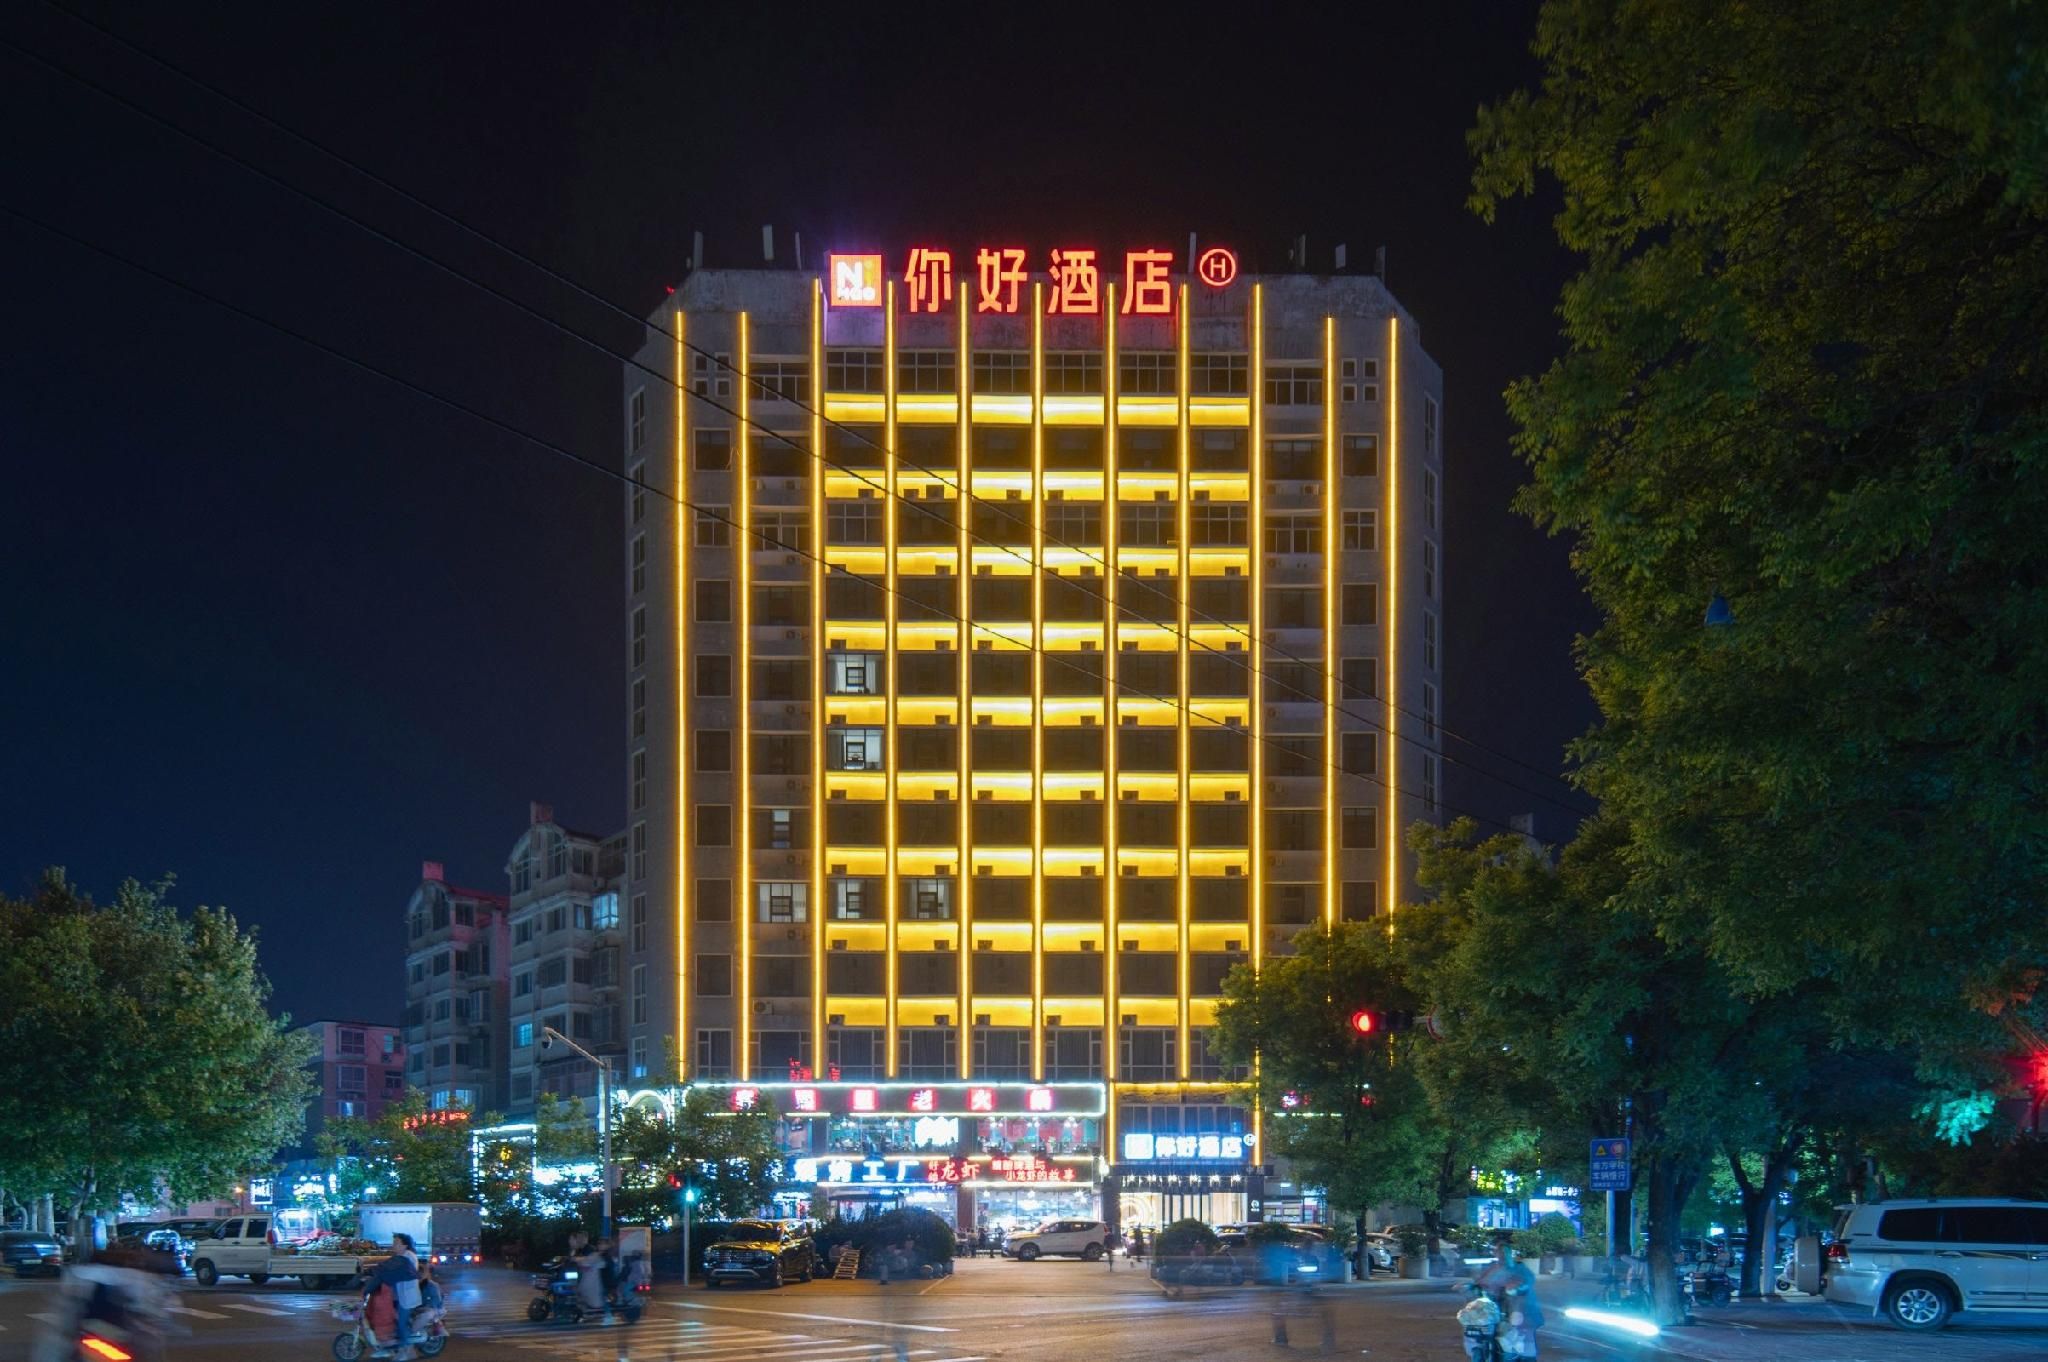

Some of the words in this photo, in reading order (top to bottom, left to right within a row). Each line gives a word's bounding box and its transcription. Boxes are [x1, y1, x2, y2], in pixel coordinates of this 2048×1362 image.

[903, 248, 1174, 315] 你好酒店
[1005, 1167, 1075, 1183] 小龙虾的故事
[1592, 1171, 1626, 1181] 车辆慢行
